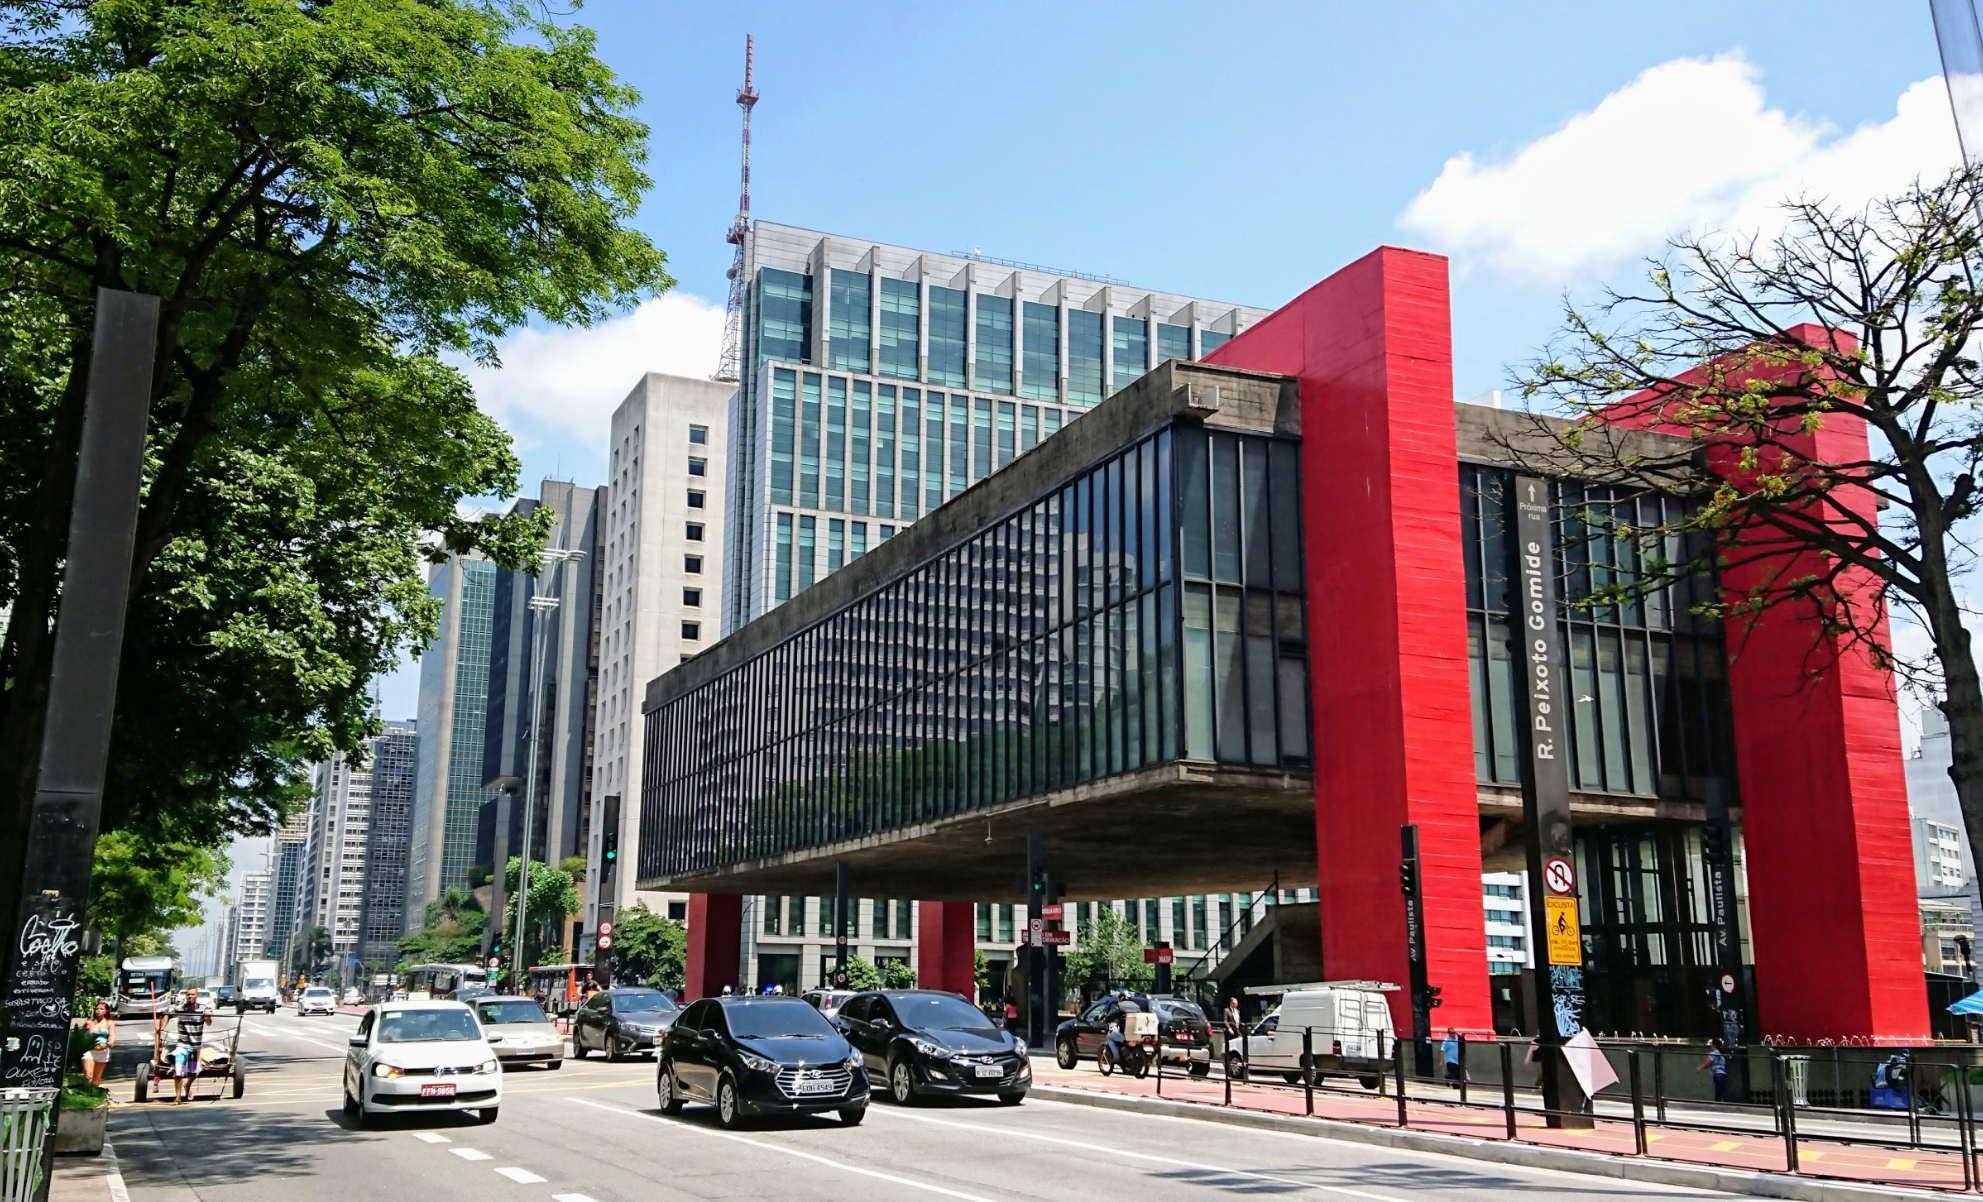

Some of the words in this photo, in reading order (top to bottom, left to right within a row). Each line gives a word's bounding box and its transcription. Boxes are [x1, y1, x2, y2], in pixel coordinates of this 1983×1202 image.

[1519, 502, 1548, 513] Próxima
[1528, 513, 1541, 521] rua
[1524, 541, 1545, 631] Gomide
[1527, 638, 1553, 732] Peixoto
[1537, 739, 1554, 760] R.
[1714, 870, 1726, 925] Paulista
[1407, 900, 1415, 944] Paulista
[1717, 928, 1728, 947] Av.
[1409, 946, 1418, 962] Av.
